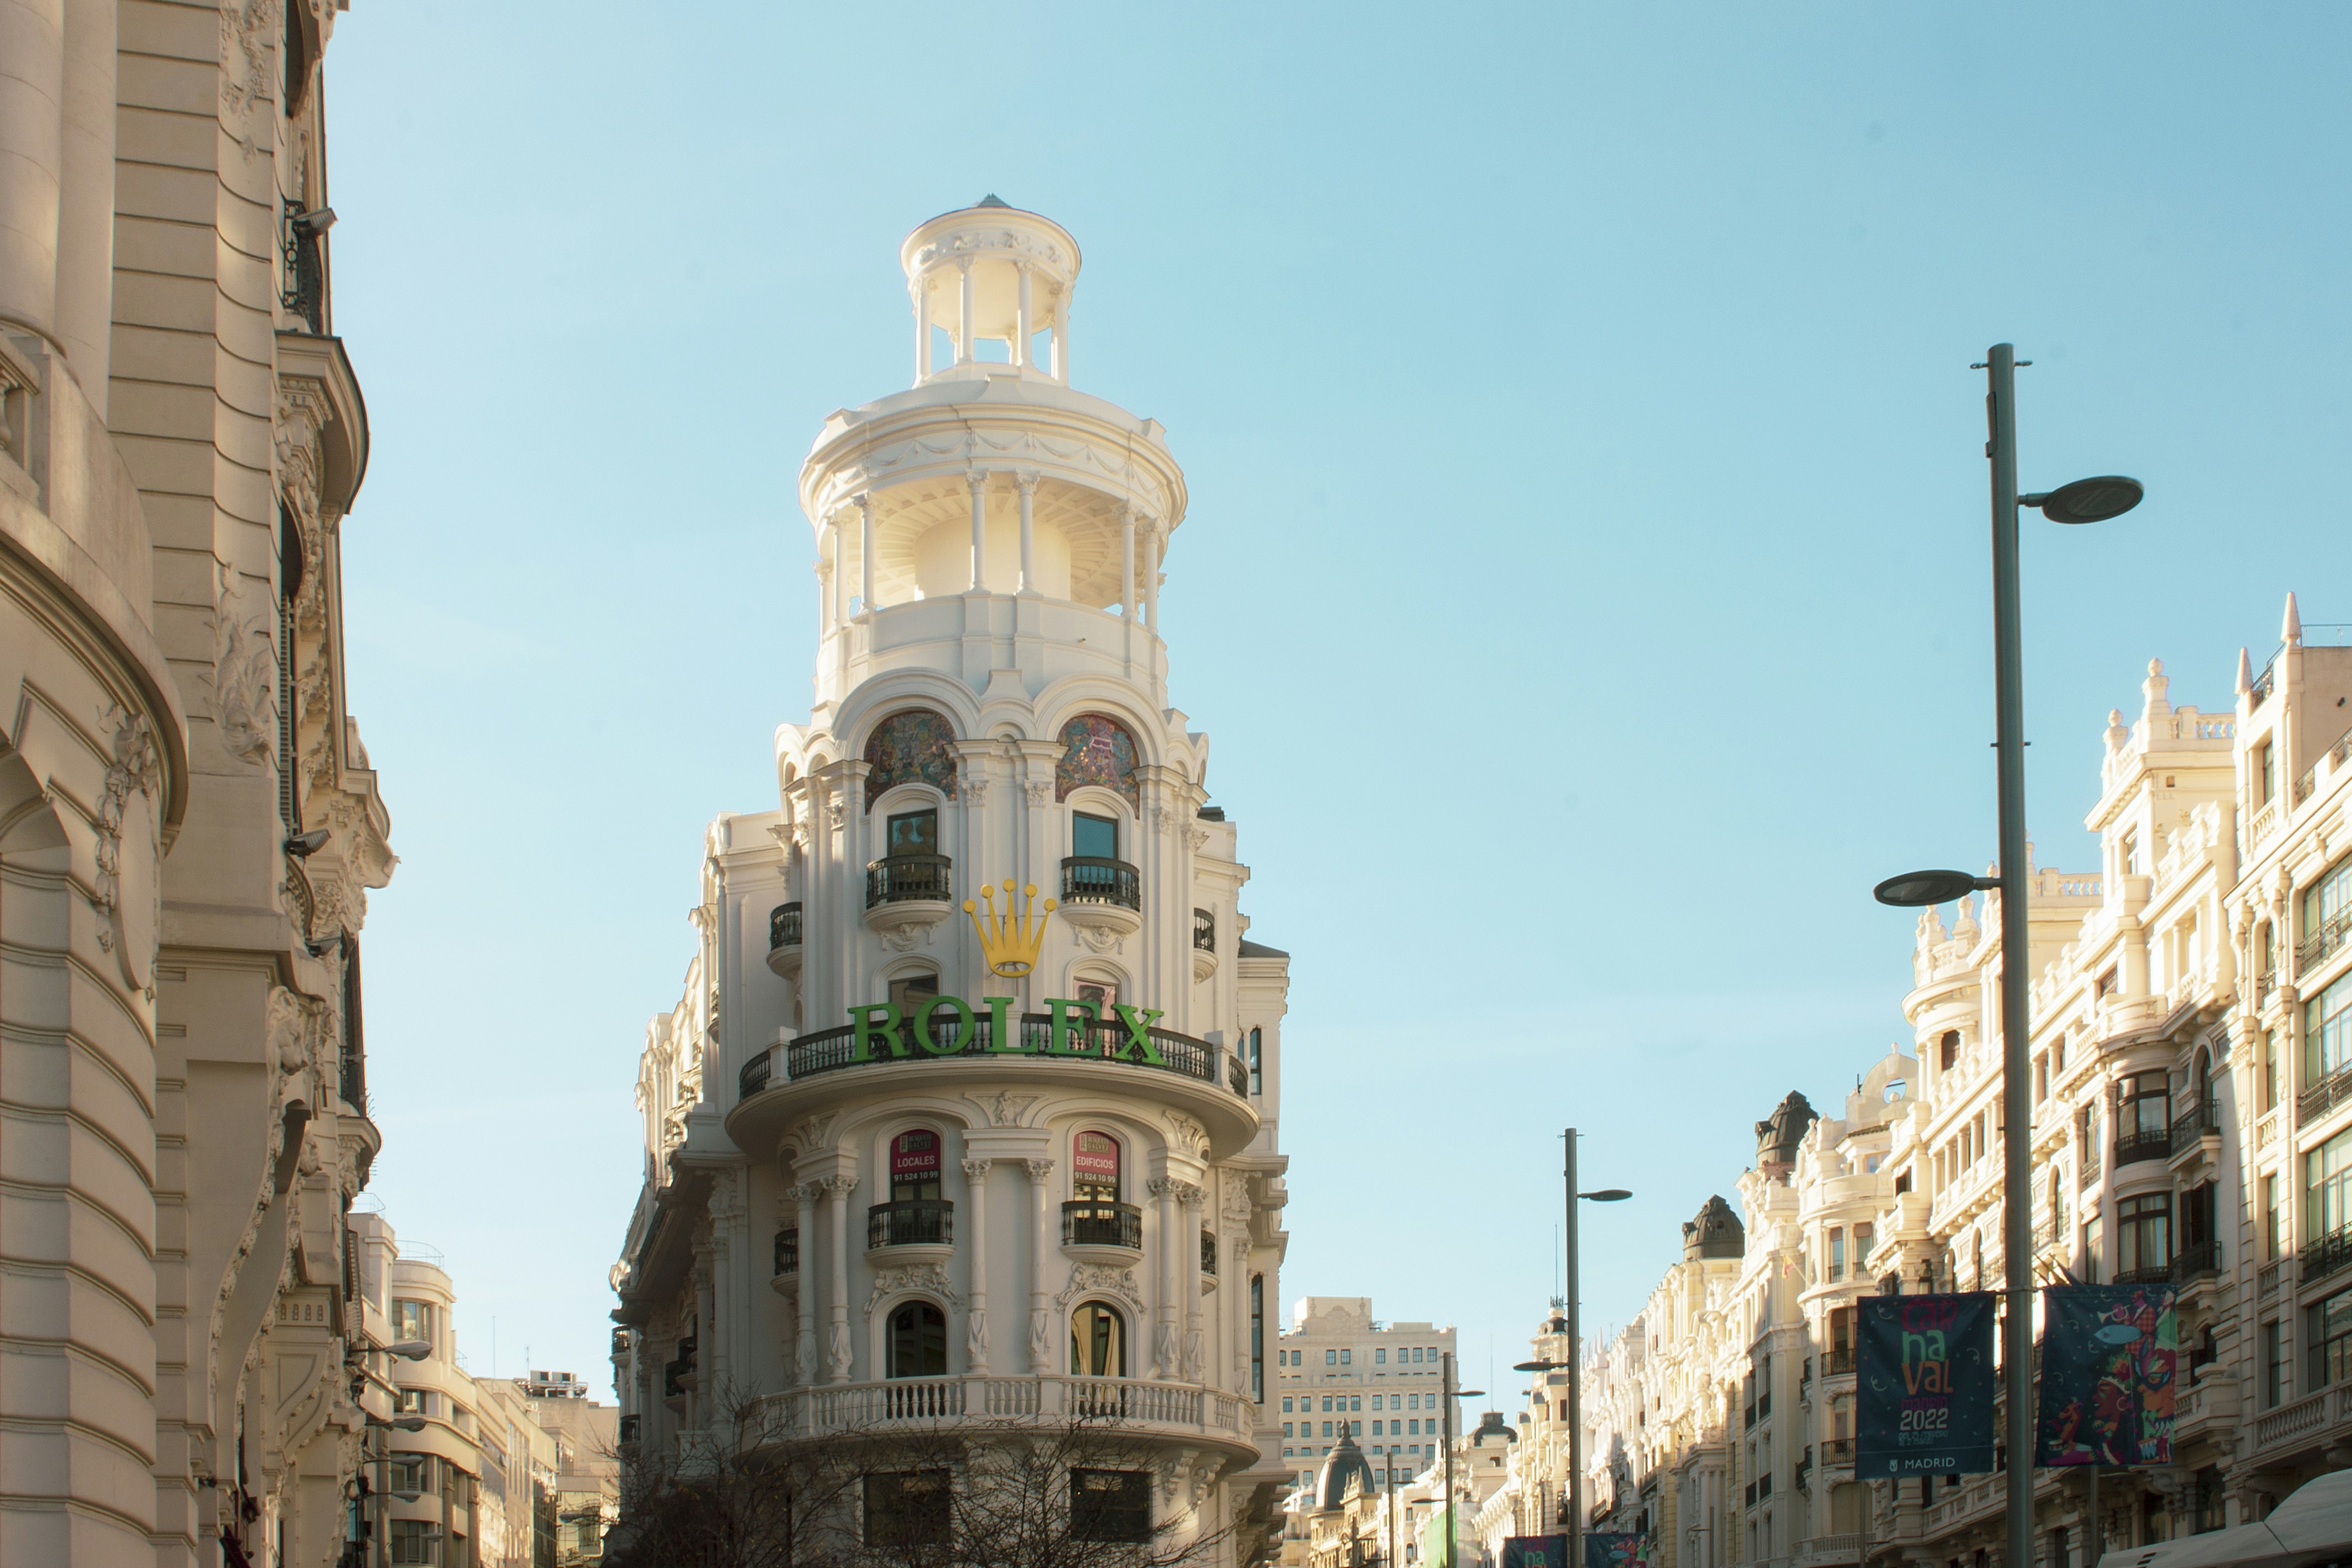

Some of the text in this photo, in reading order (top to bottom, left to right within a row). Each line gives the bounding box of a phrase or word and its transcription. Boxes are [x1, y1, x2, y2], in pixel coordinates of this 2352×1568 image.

[848, 995, 1168, 1066] ROLEX
[897, 1155, 935, 1168] LOCALES
[1076, 1156, 1114, 1169] EDIFICIOS
[1902, 1330, 1945, 1363] na
[1899, 1408, 1948, 1430] 2022
[1905, 1457, 1955, 1469] MADRID
